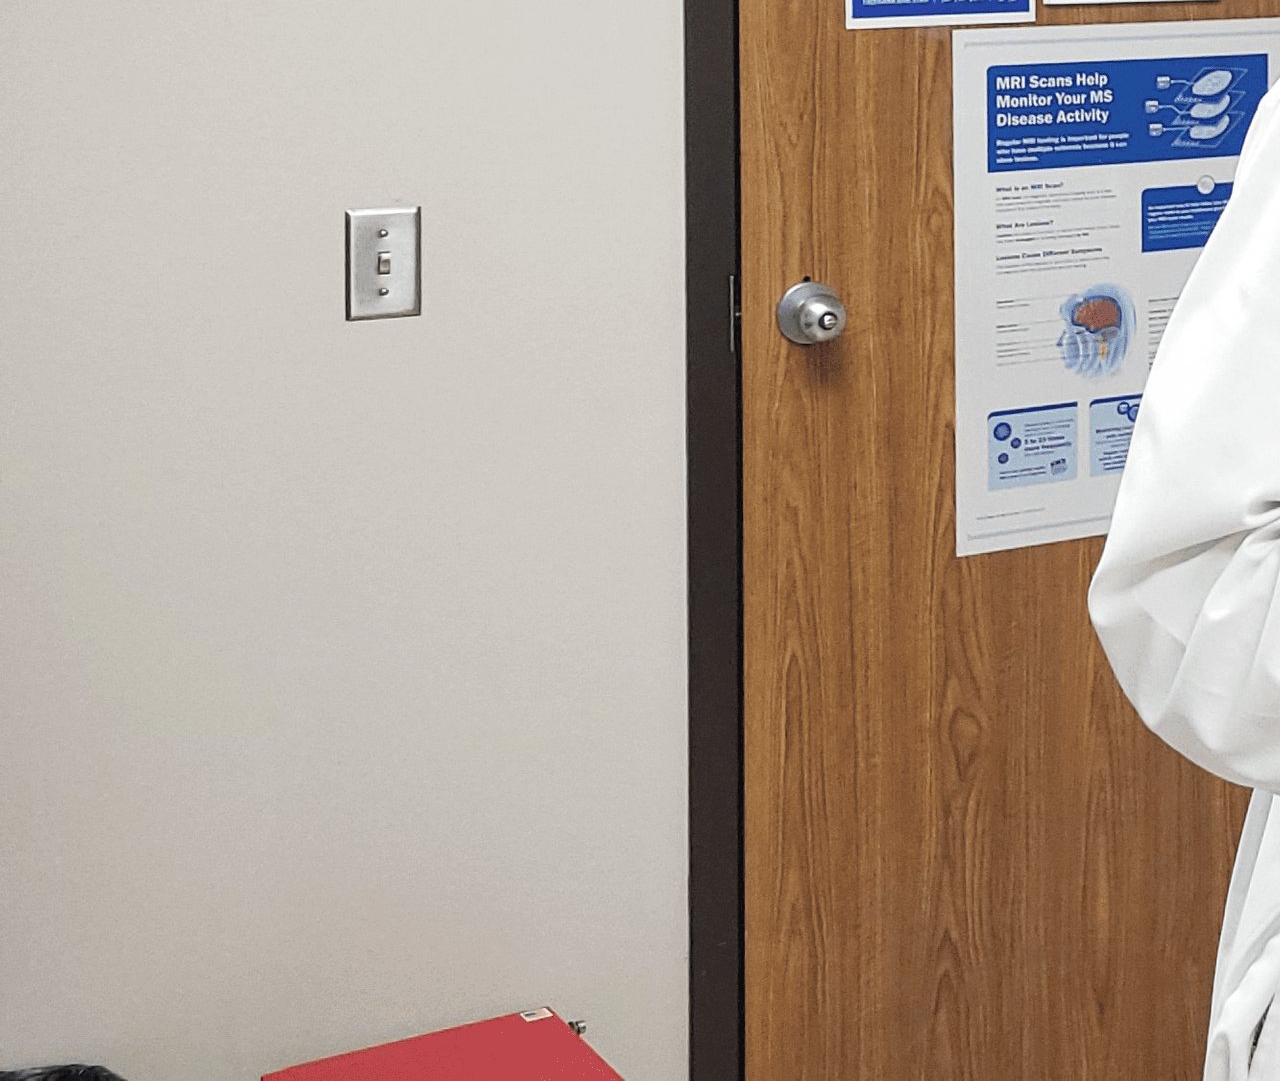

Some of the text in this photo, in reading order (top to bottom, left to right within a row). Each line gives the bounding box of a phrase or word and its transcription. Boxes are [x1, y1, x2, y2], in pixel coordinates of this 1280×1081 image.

[996, 72, 1109, 90] MRI Scans Help
[996, 89, 1113, 108] Monitor Your MS
[996, 108, 1109, 127] Disease Activity
